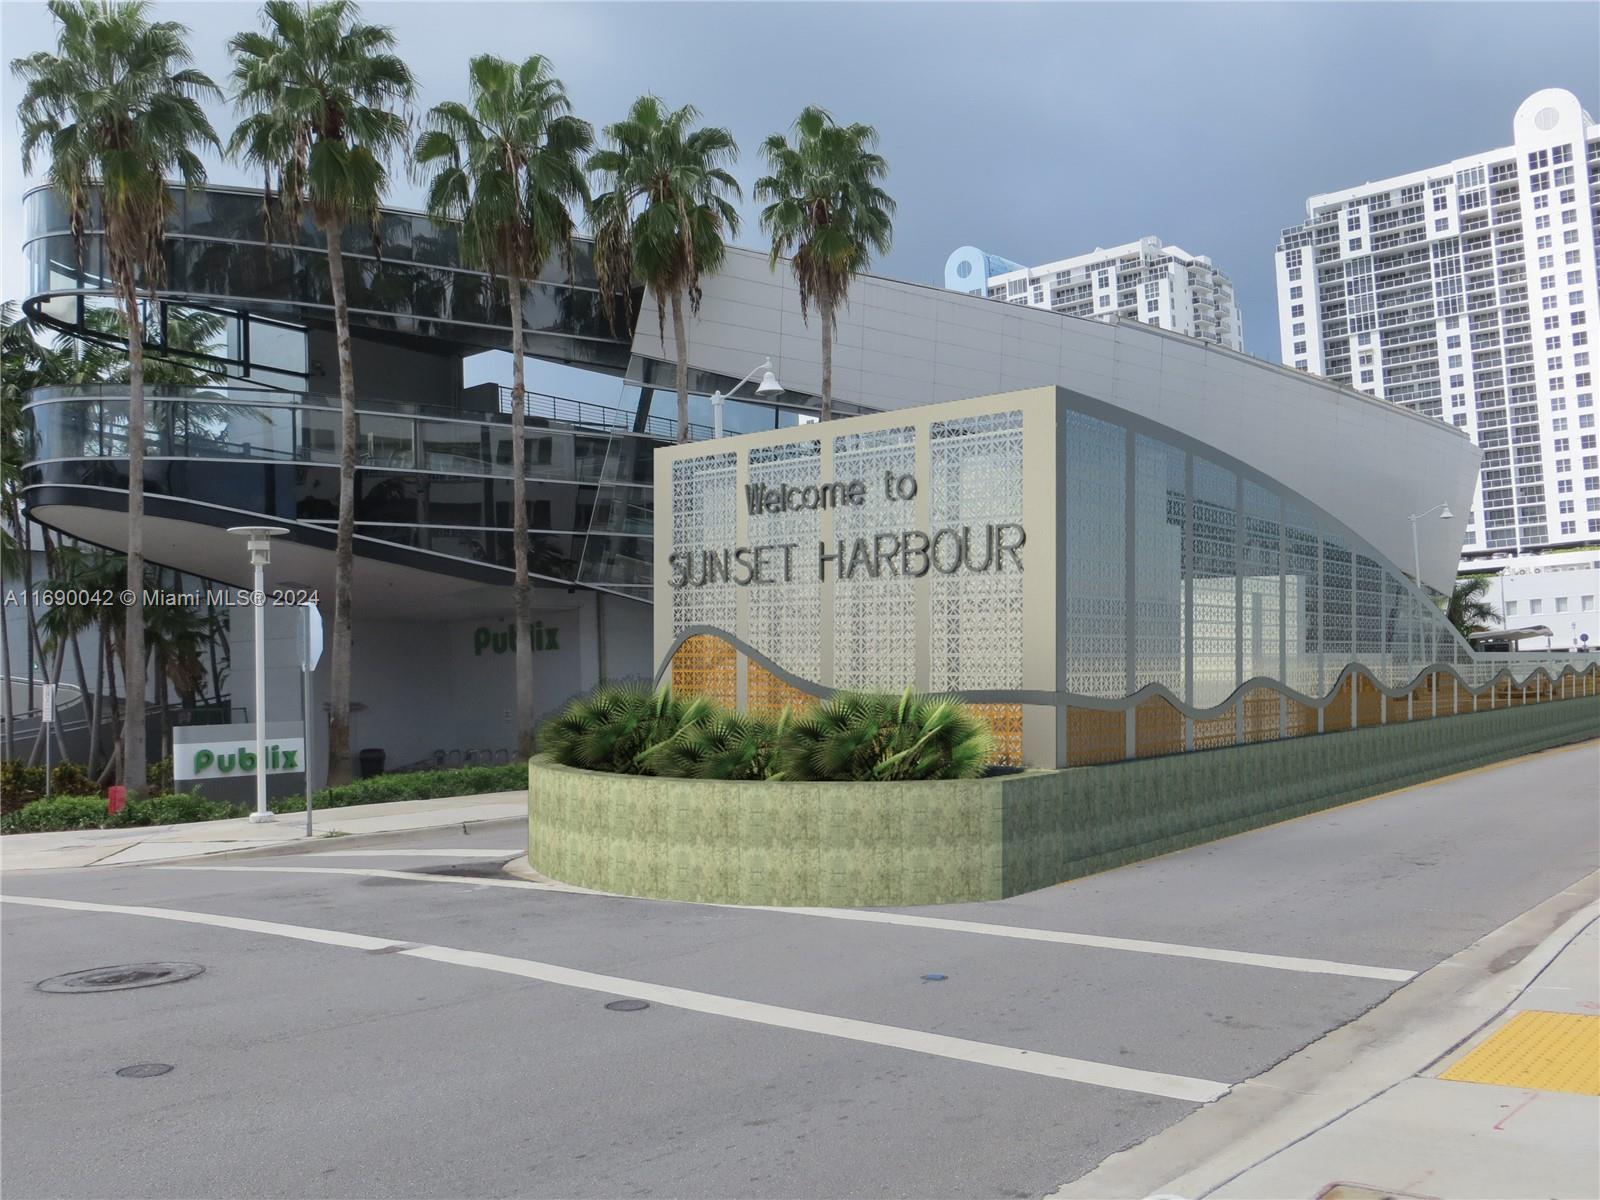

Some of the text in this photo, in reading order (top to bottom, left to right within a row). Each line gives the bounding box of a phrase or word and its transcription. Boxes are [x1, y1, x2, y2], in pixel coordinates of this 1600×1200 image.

[744, 470, 918, 516] Welcome to
[667, 523, 1027, 588] SUNSET HARBOUR
